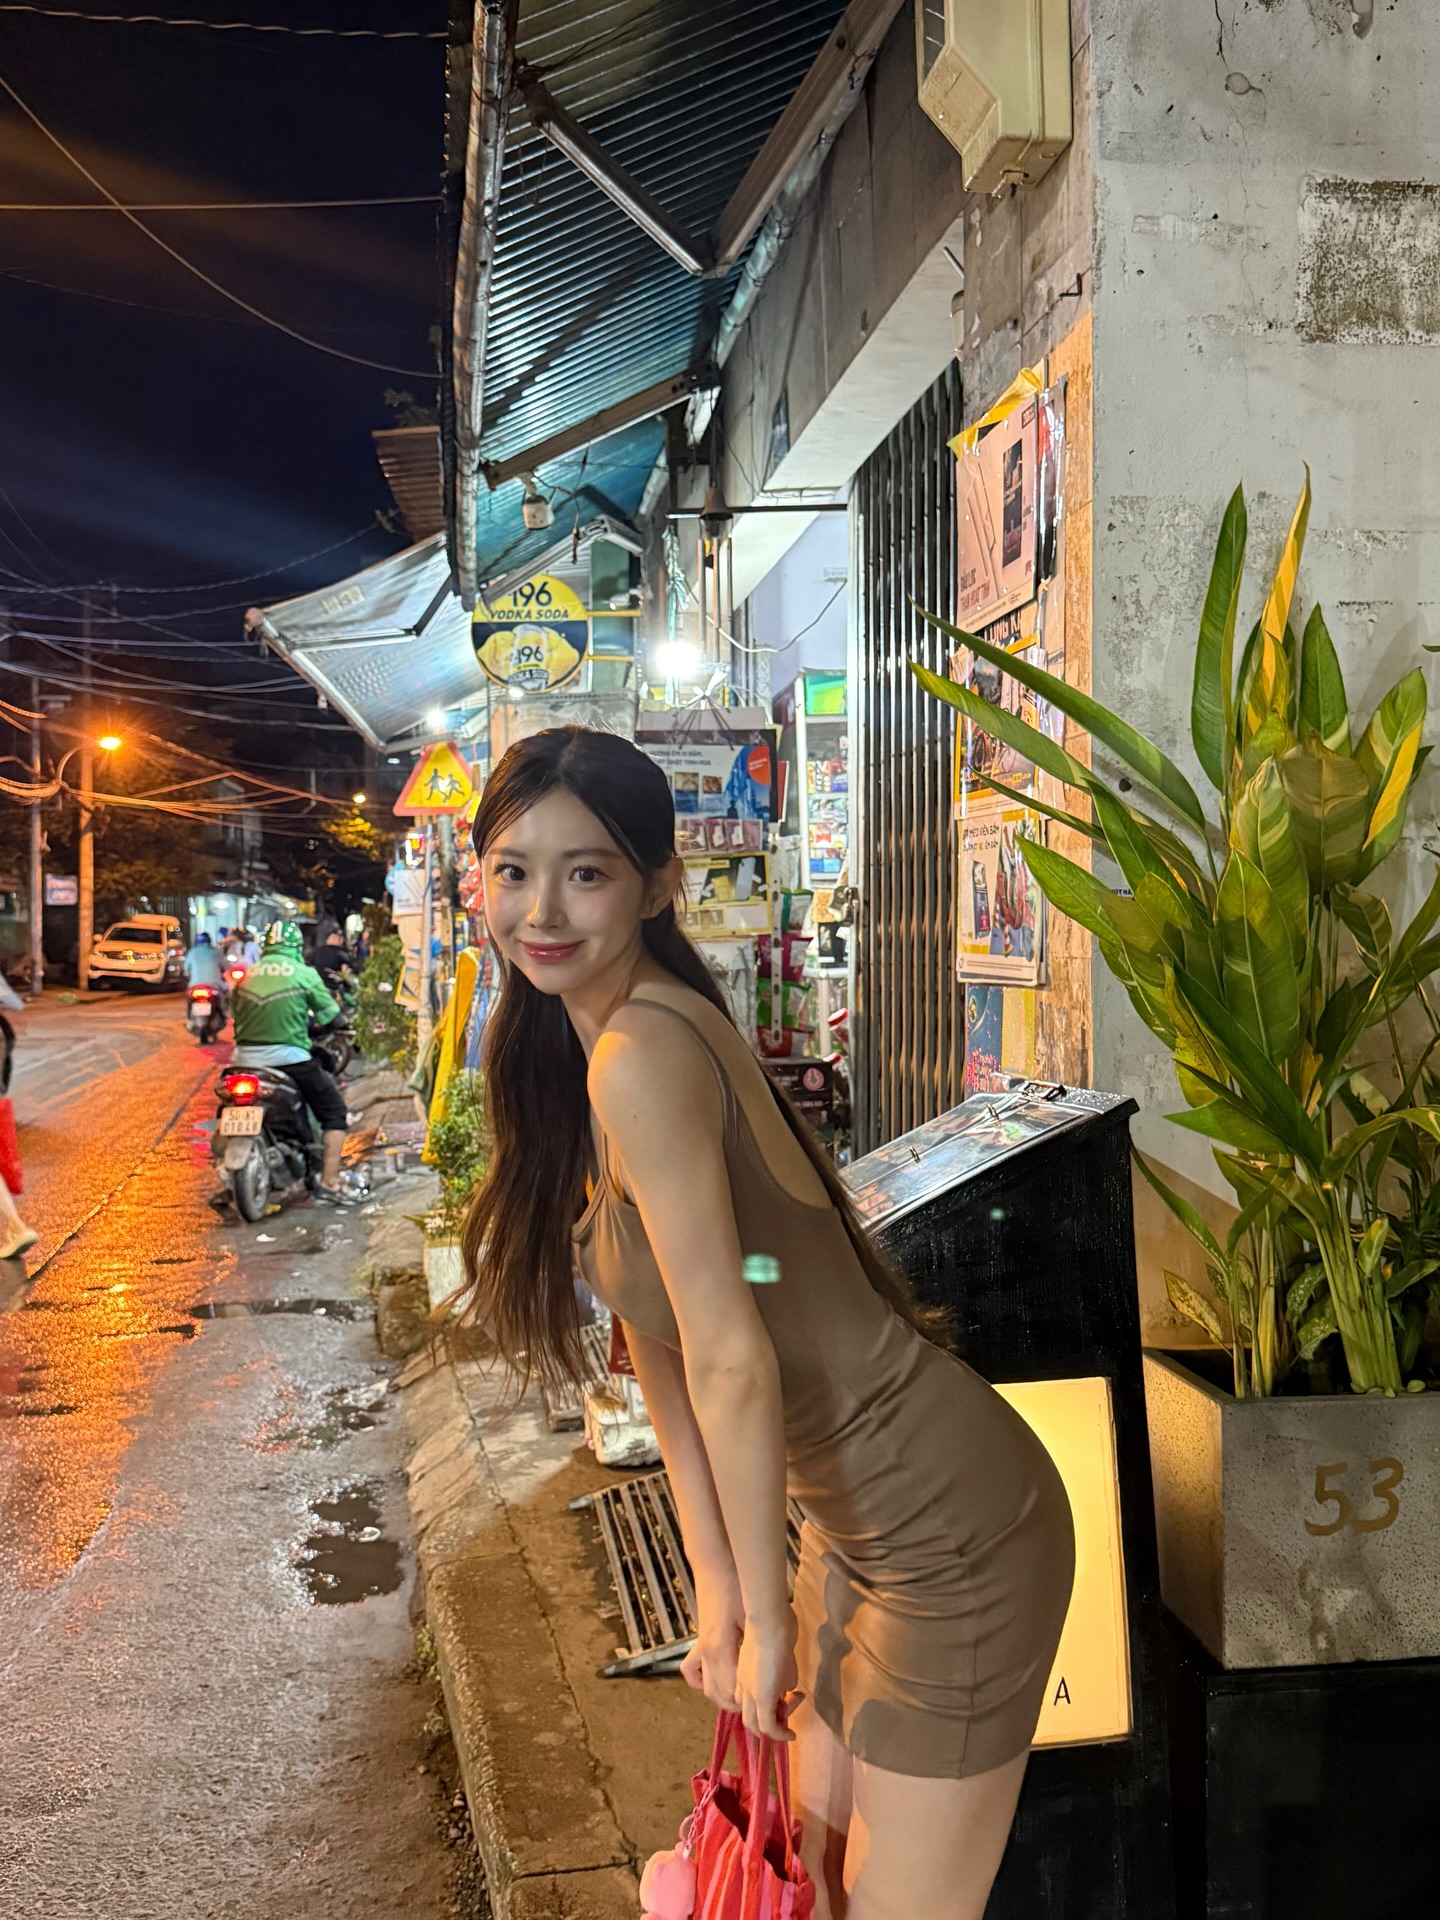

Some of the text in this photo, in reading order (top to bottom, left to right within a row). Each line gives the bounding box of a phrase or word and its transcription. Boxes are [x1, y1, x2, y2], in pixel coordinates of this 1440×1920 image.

[490, 609, 569, 620] VODKA SODA
[1304, 1457, 1404, 1537] 53
